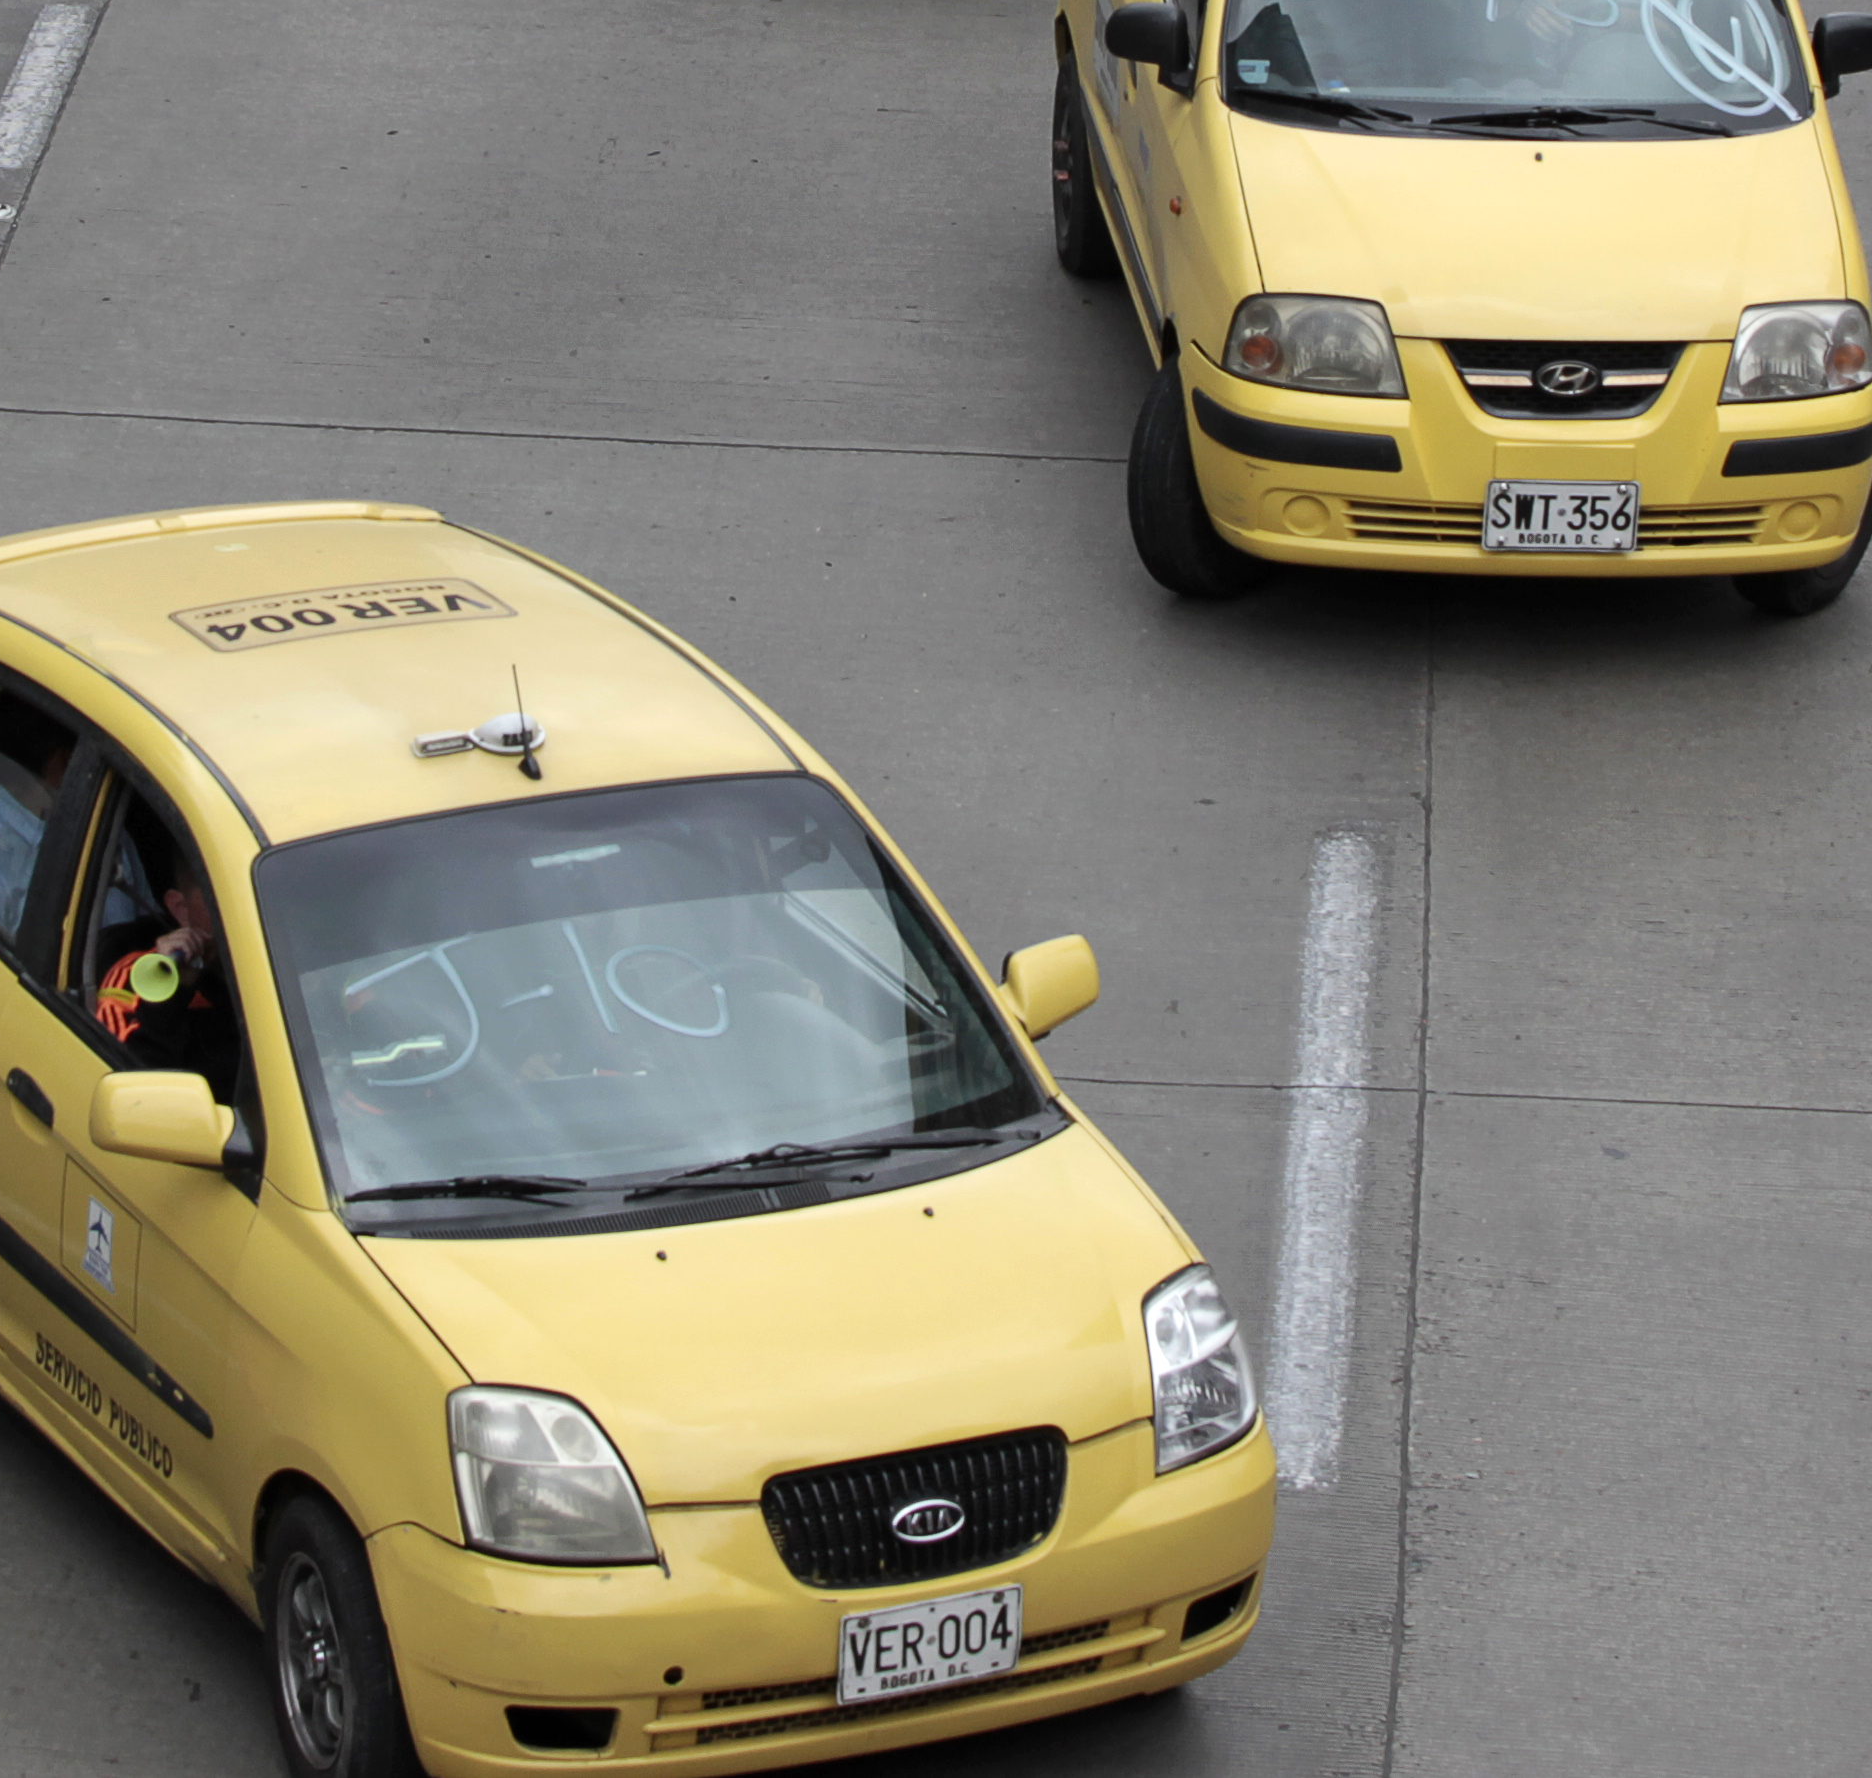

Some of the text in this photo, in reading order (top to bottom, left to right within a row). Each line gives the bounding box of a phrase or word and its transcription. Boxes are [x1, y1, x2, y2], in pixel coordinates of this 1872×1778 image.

[1518, 533, 1566, 544] BOGOTA
[321, 585, 446, 600] BOGOTA
[337, 594, 494, 620] VER
[206, 609, 336, 642] 004
[36, 1332, 173, 1478] SERVICIO PUBLICO
[905, 1508, 953, 1535] KIA
[881, 1669, 935, 1690] BOGOTA
